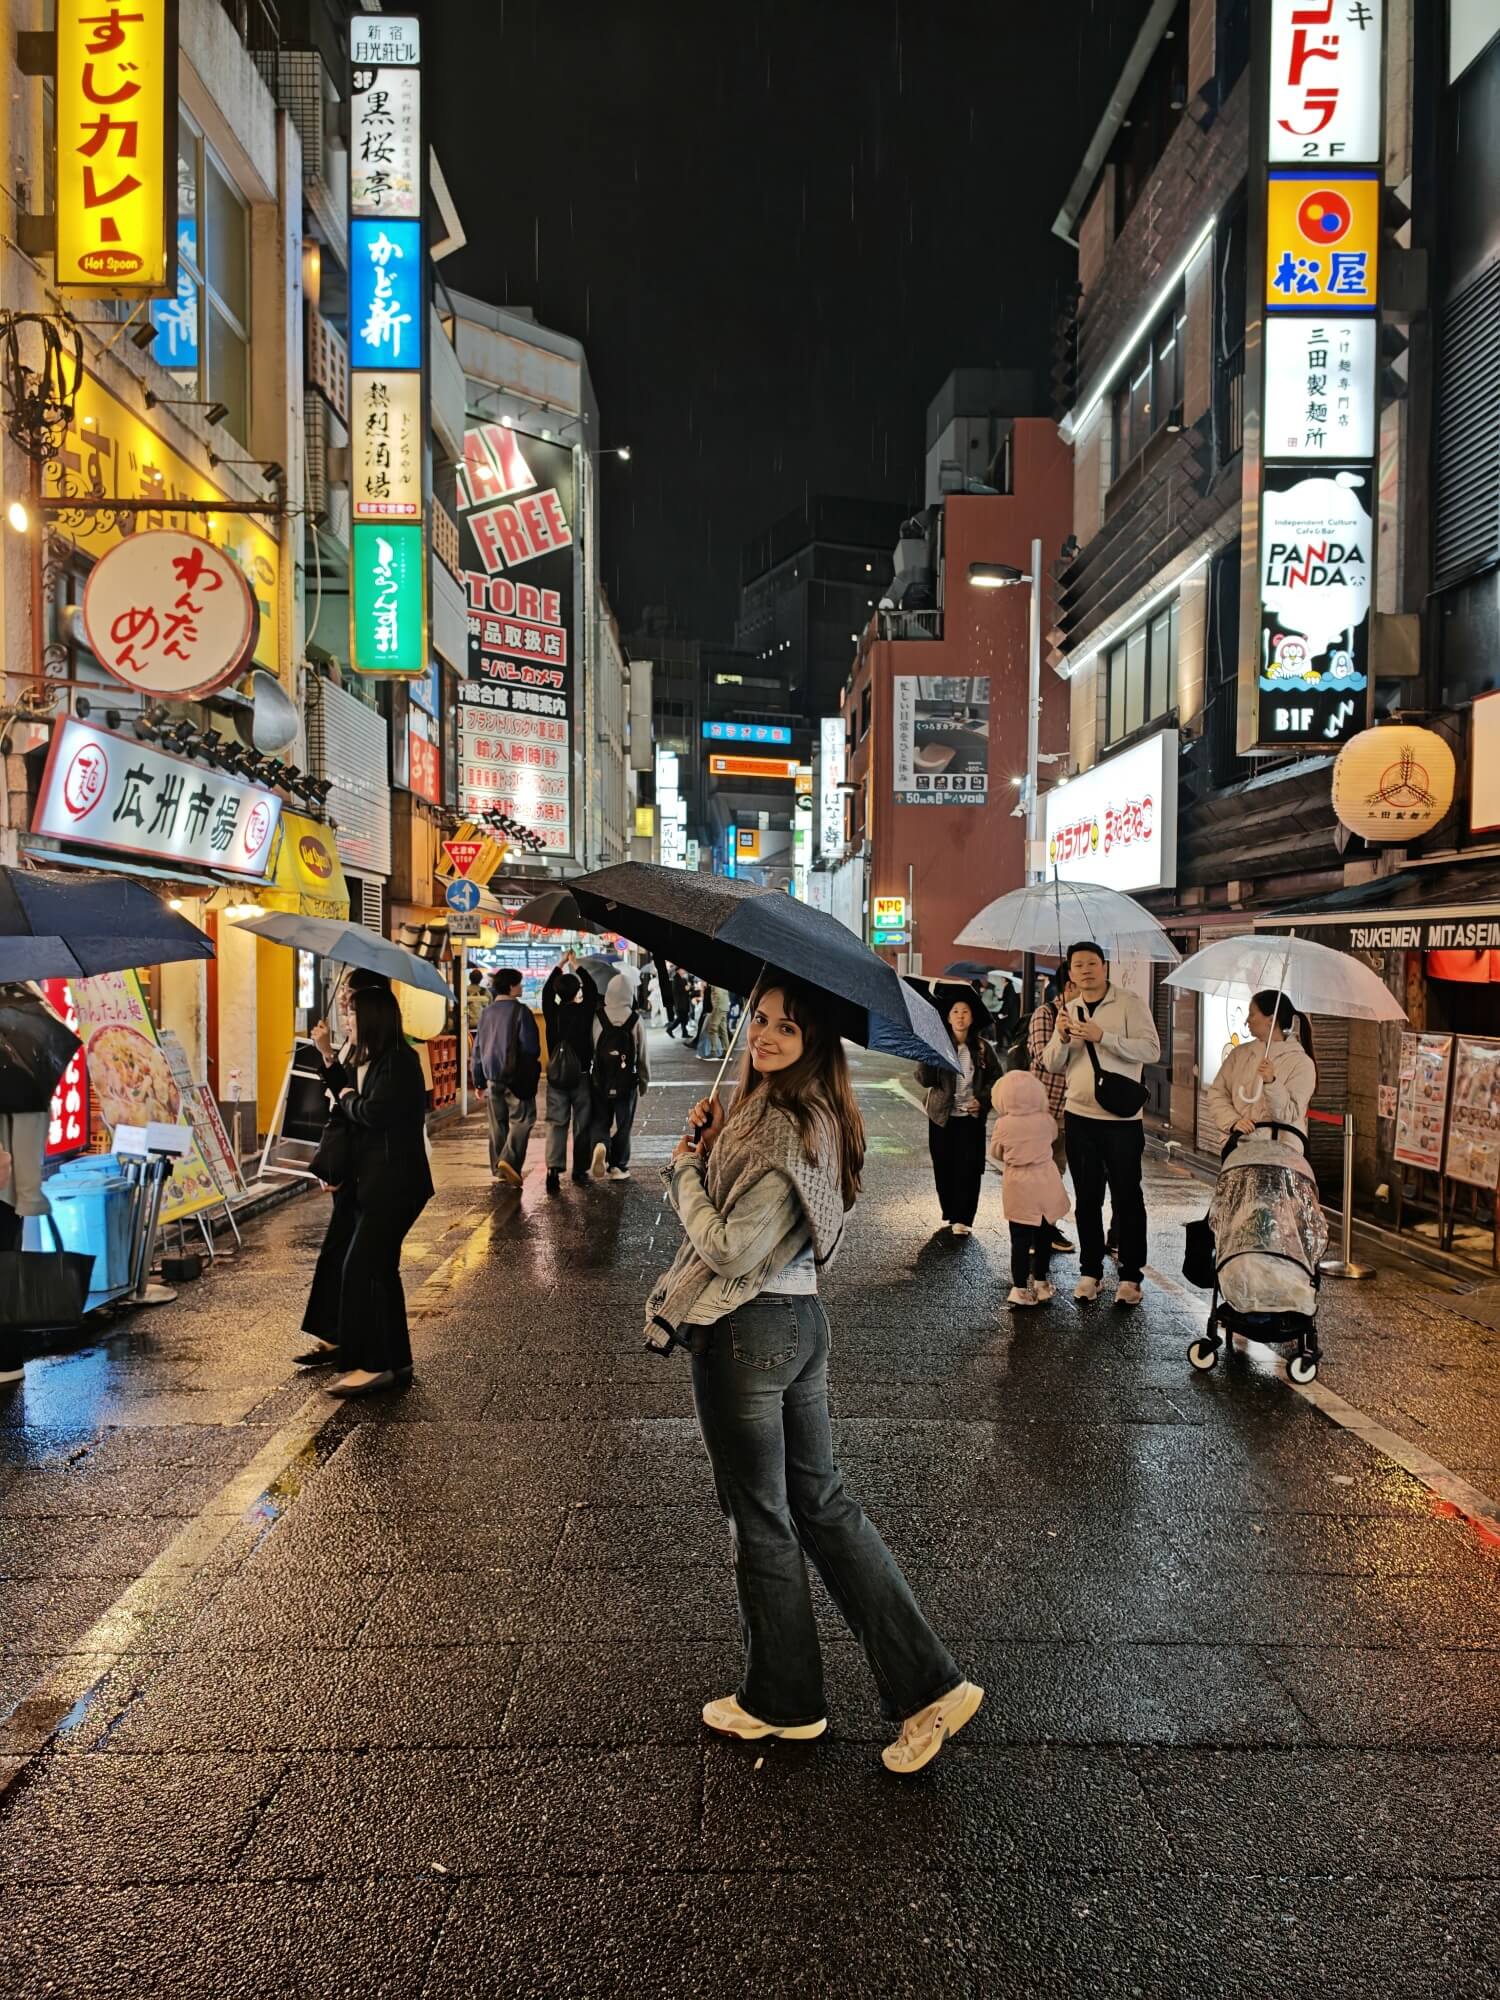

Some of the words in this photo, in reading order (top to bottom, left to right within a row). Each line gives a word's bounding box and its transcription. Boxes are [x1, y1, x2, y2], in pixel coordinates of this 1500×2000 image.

[368, 25, 403, 41] 新宿
[353, 71, 372, 89] 3F
[76, 0, 145, 242] すじカレー
[361, 91, 395, 206] 黒桜亭
[1302, 143, 1346, 157] 2F
[84, 256, 104, 269] Hot
[106, 257, 138, 271] Spoon
[1274, 252, 1367, 294] 松屋
[360, 231, 412, 358] かど新
[1305, 327, 1330, 449] 三田製麺所
[1337, 328, 1351, 427] つけ麺専門店
[364, 380, 391, 498] 熱烈酒場
[467, 489, 573, 574] FREE
[1275, 519, 1324, 527] Independent
[1328, 518, 1357, 526] Culture
[1266, 563, 1347, 590] LINDA
[1270, 541, 1365, 571] PANDA
[163, 547, 222, 660] わんたん
[459, 569, 561, 626] TORE
[111, 606, 159, 672] めん
[474, 738, 559, 769] 輸入腕時計
[112, 763, 241, 852] 広州市場
[1104, 797, 1153, 854] まねきねこ
[451, 846, 476, 855] 止まれ
[1056, 821, 1091, 862] カラオケ
[878, 900, 902, 912] NPC
[1351, 927, 1421, 948] TSUKEMEN
